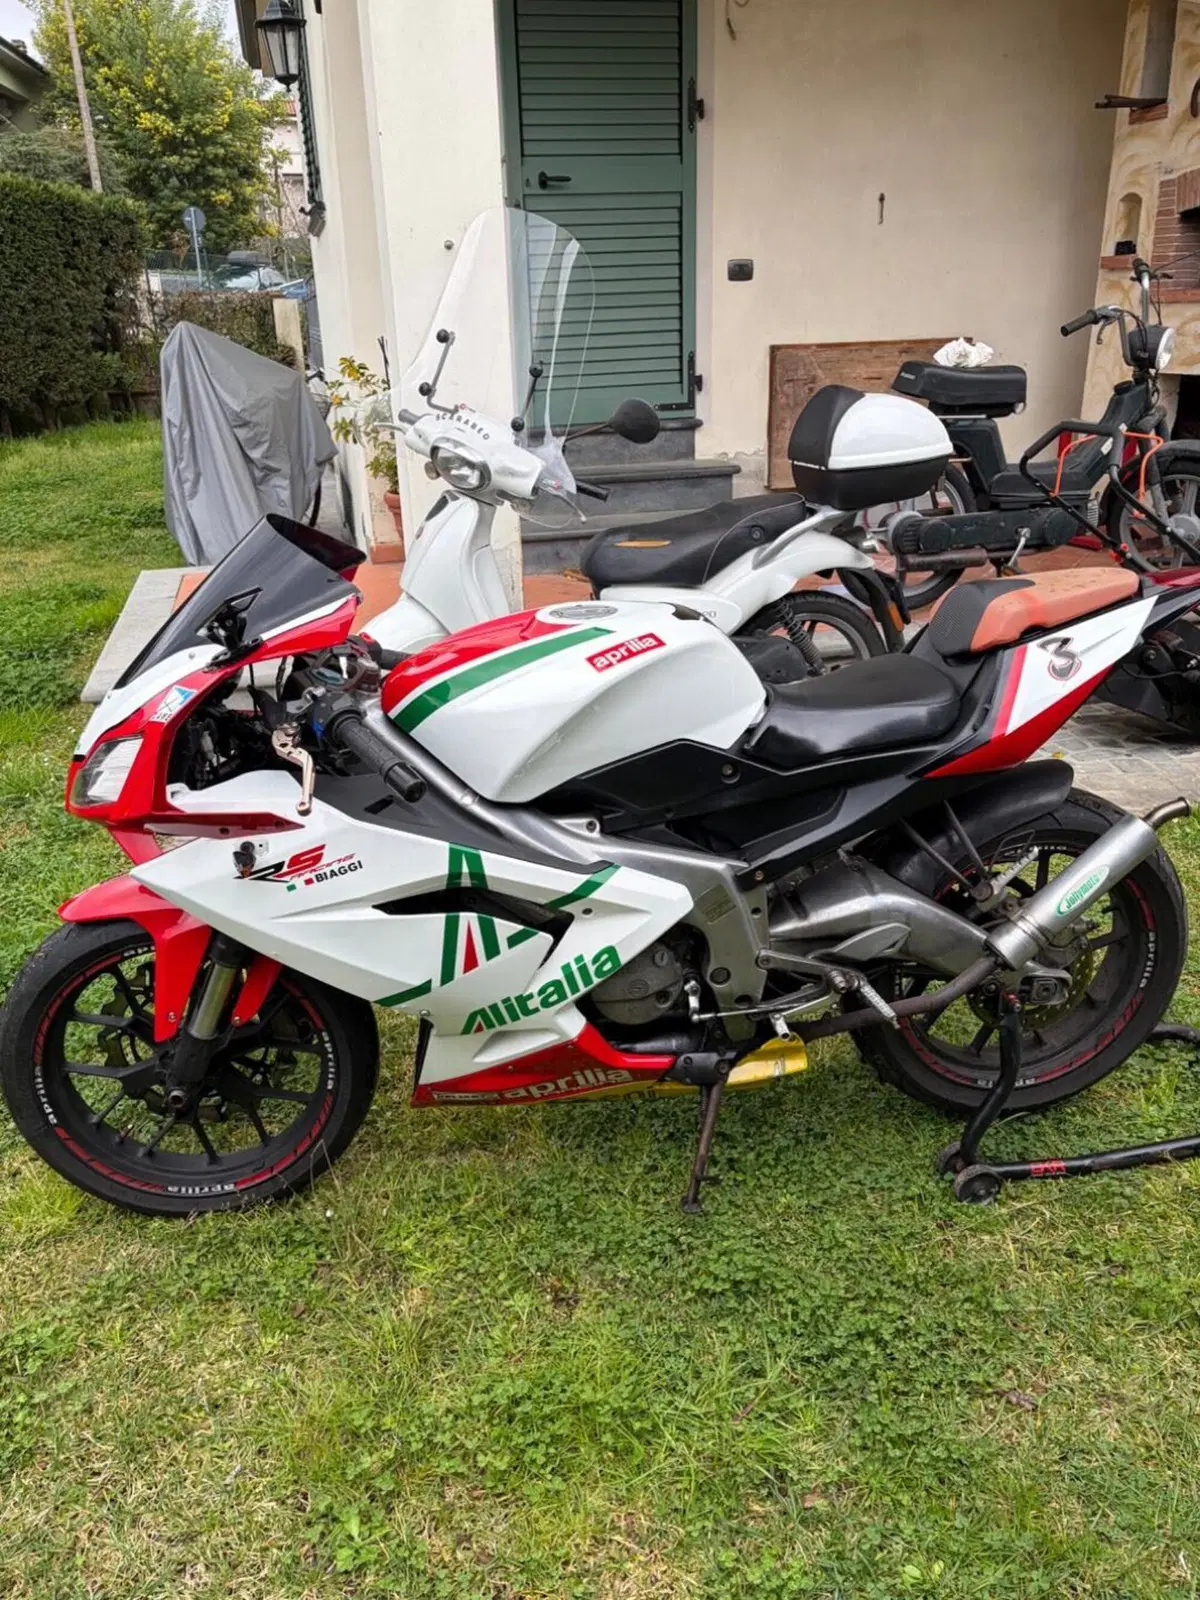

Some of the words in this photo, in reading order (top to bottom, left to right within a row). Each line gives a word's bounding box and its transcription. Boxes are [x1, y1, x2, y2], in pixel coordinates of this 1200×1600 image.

[435, 412, 491, 441] SCARABEO
[593, 635, 660, 668] aprilia
[314, 859, 363, 883] BIAGGI
[1138, 931, 1156, 988] aprilia
[460, 945, 622, 1036] Alitalia
[322, 1031, 336, 1090] aprilia
[34, 1066, 58, 1125] aprilia
[500, 1068, 634, 1099] aprilia
[167, 1183, 235, 1194] aprilia
